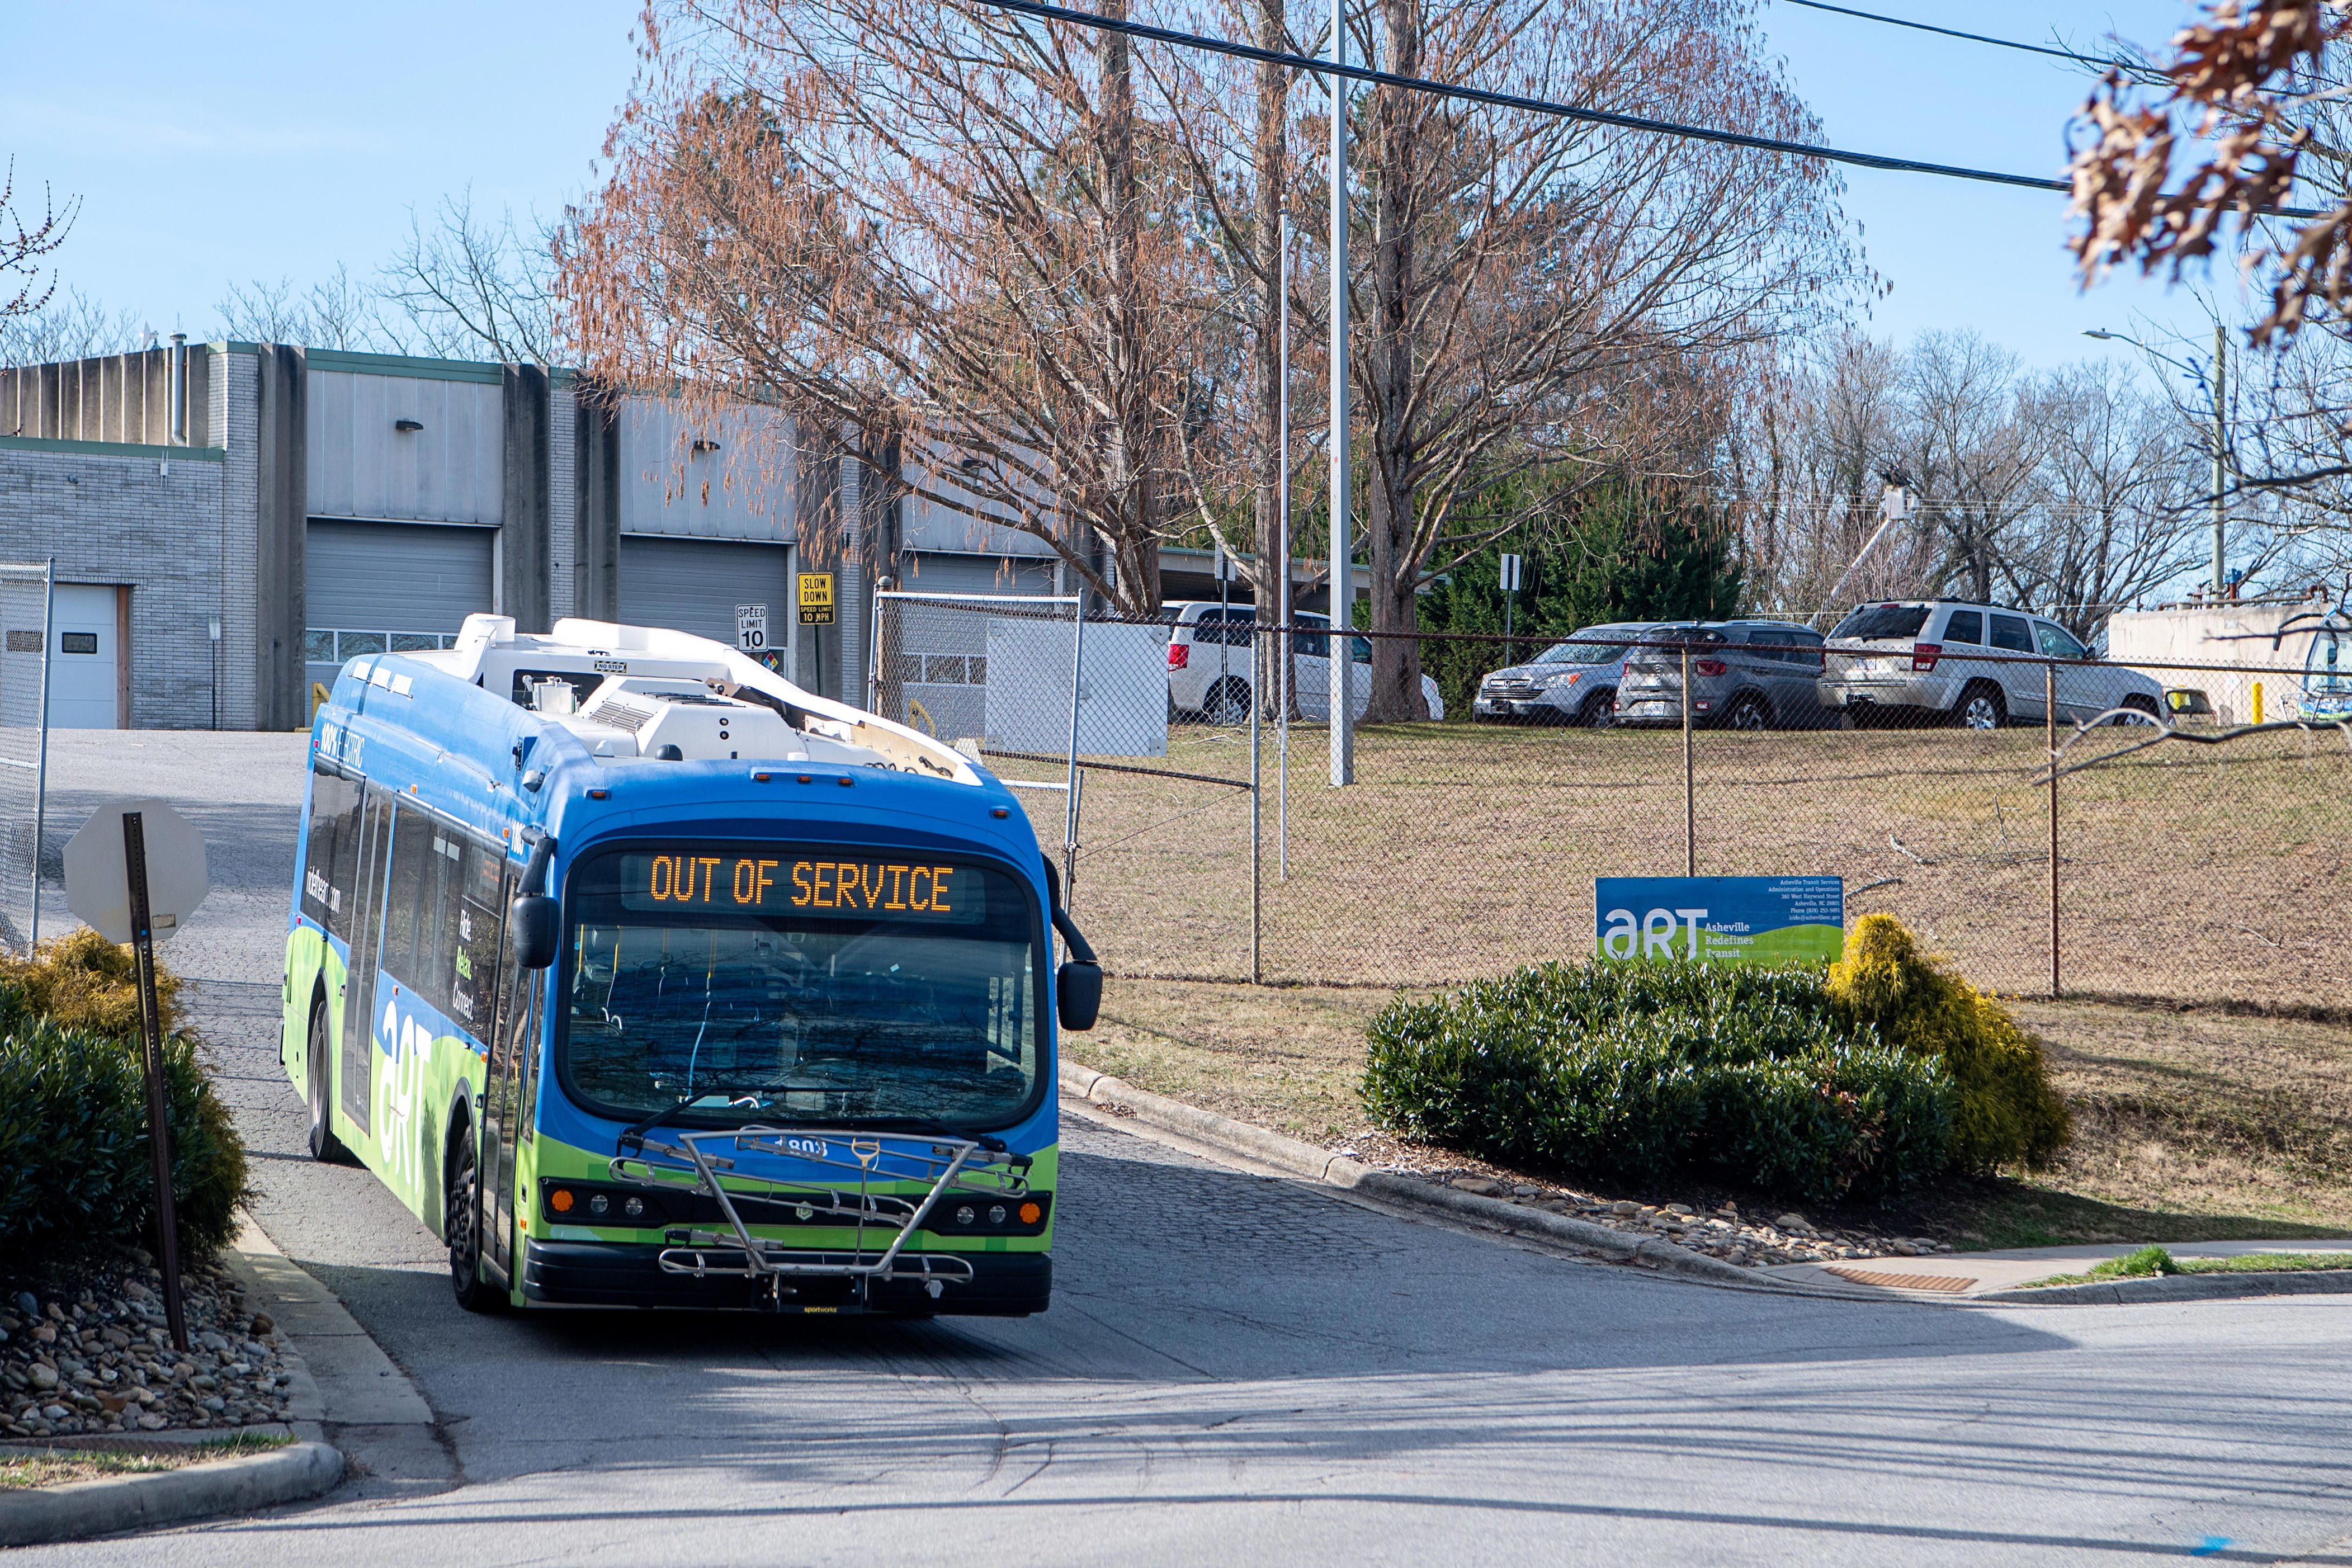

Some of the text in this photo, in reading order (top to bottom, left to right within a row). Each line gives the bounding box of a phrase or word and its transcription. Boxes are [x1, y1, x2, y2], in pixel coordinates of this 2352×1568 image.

[804, 578, 826, 589] SLOW
[804, 591, 827, 602] DOWN
[739, 608, 765, 617] SPEED
[804, 613, 813, 621] 10
[742, 620, 762, 629] LIMIT
[742, 630, 763, 646] 10
[320, 722, 338, 757] 100%
[650, 856, 953, 911] OUT OF SERVICE
[459, 909, 471, 942] Ride.
[1705, 922, 1750, 932] Asheville
[1706, 936, 1754, 945] Redefines
[1706, 948, 1740, 958] Transit
[456, 945, 472, 980] Relax.
[453, 981, 474, 1021] Connect.
